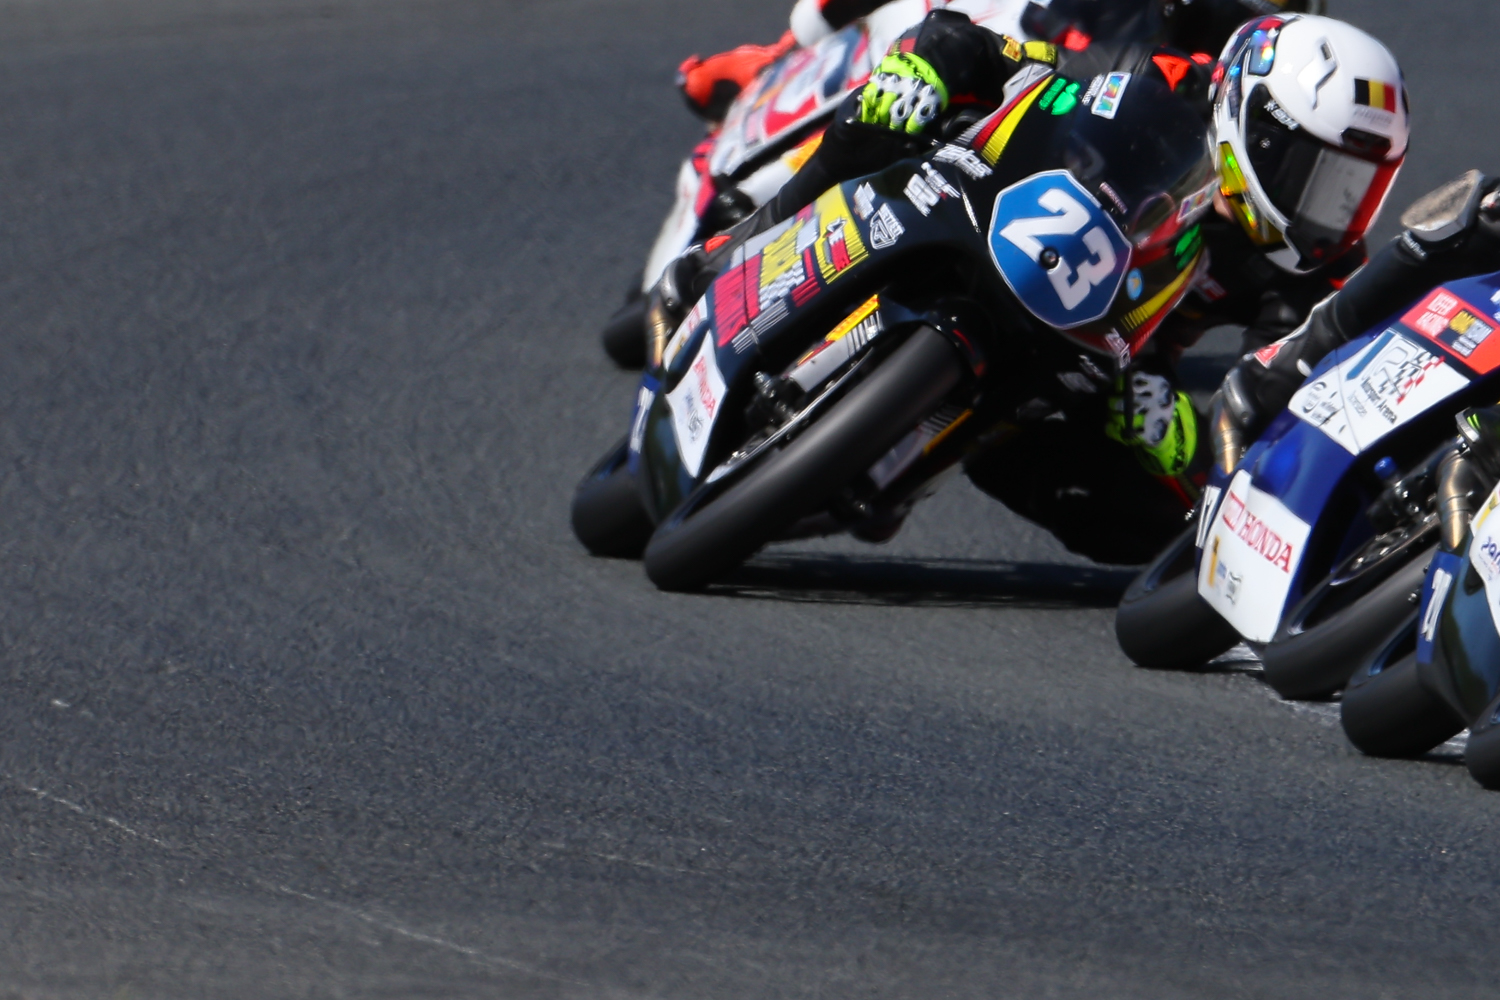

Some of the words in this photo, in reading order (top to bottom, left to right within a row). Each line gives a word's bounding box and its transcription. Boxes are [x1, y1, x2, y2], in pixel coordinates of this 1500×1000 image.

[999, 187, 1117, 311] 23
[1376, 399, 1398, 425] Arena
[1239, 514, 1293, 574] HONDA
